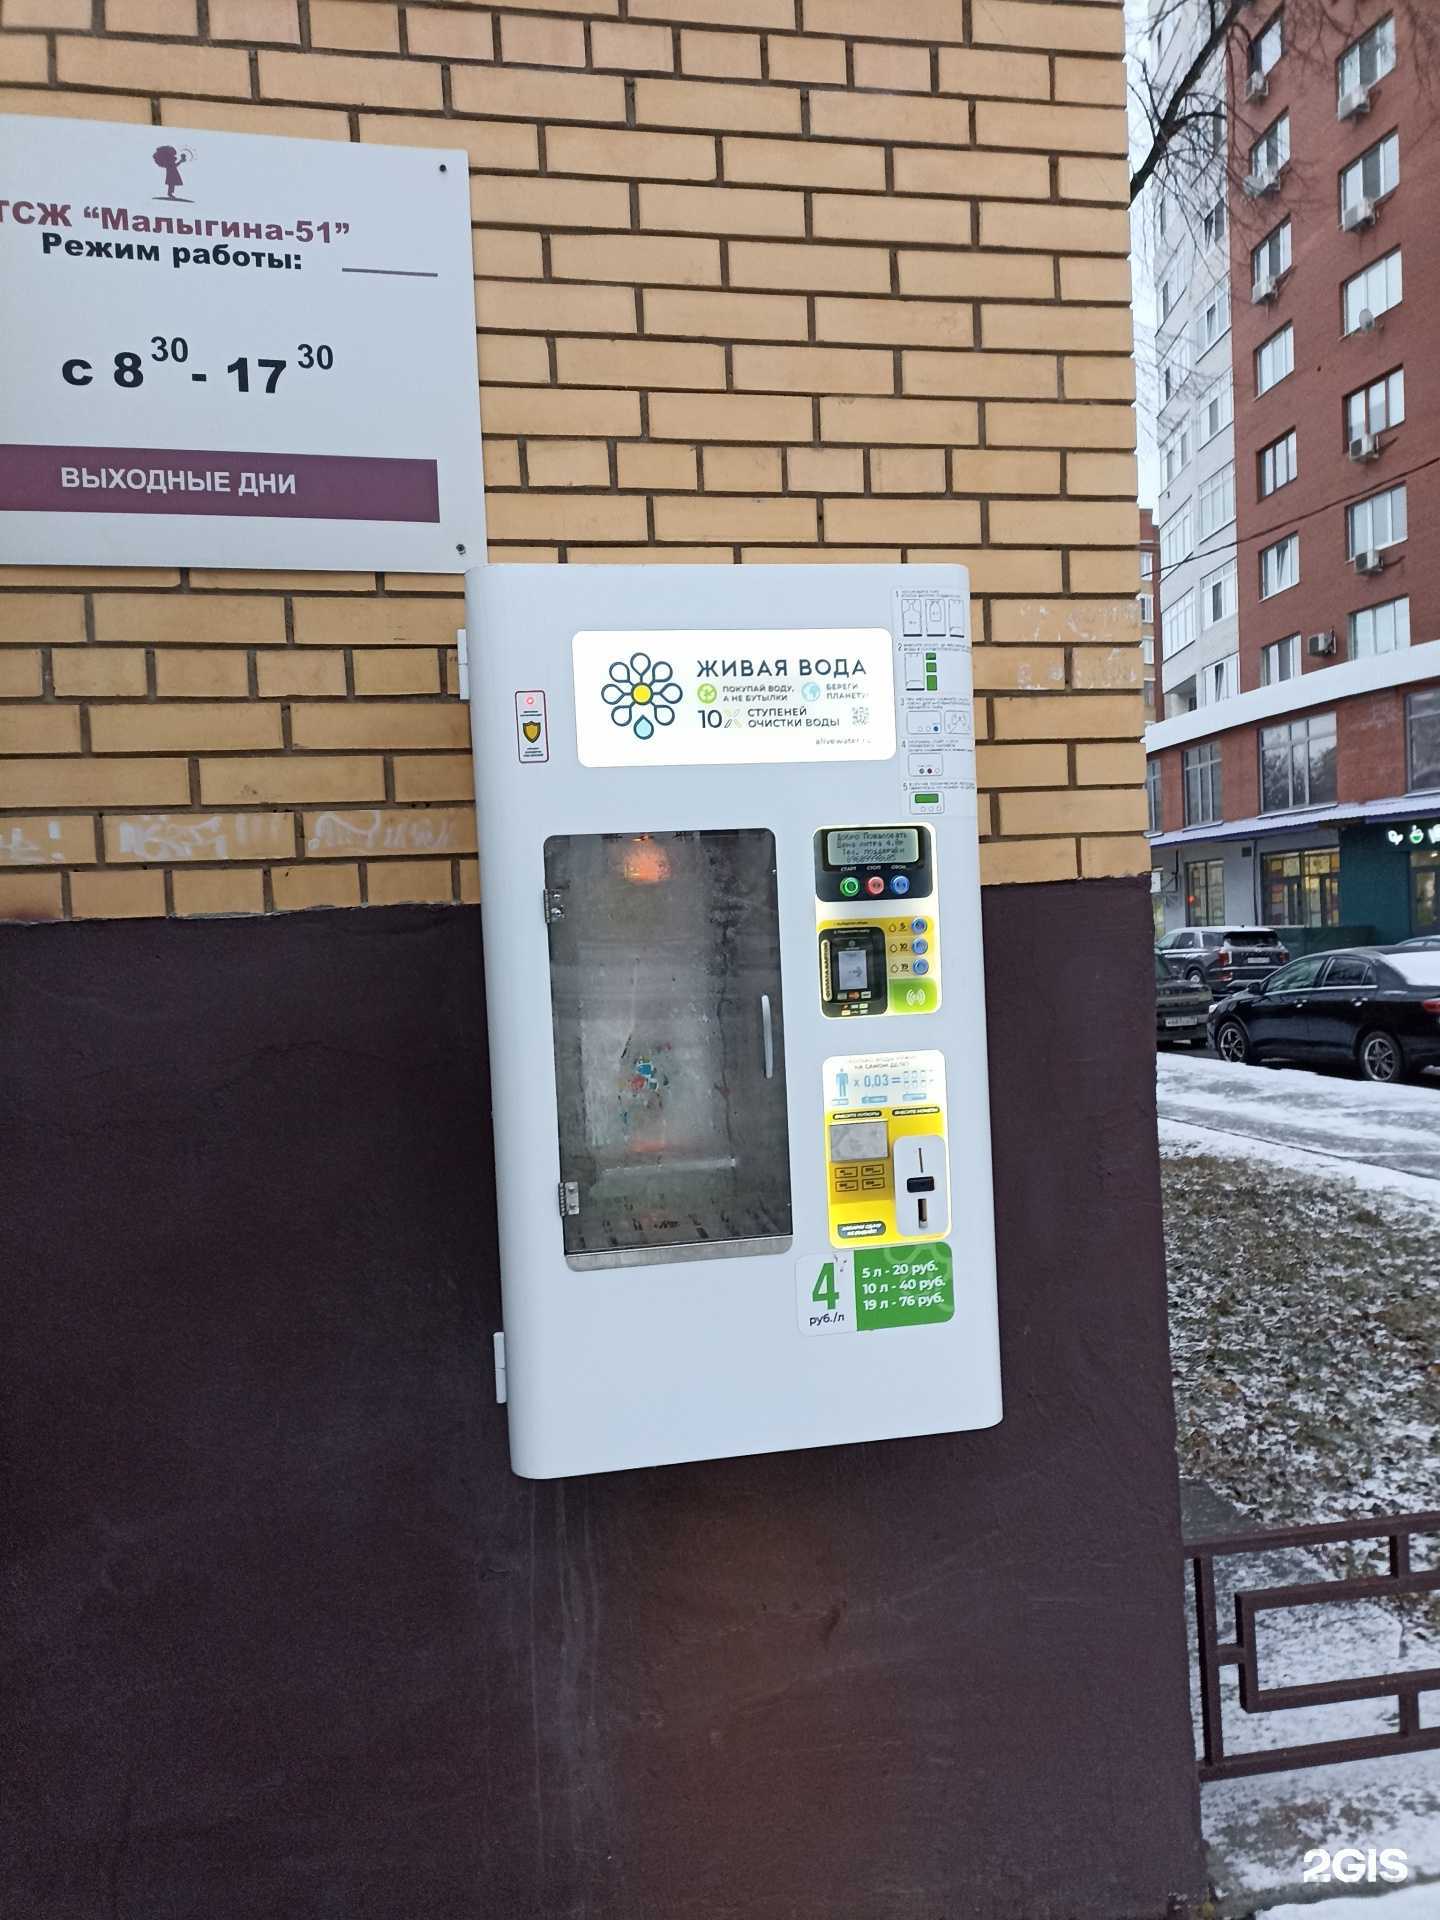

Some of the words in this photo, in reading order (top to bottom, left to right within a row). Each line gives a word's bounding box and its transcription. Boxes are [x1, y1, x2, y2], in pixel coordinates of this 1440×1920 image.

[42, 232, 160, 261] Режим
[172, 243, 302, 270] работы:
[61, 358, 94, 386] с
[61, 466, 230, 492] ВЫХОДНЫЕ
[239, 473, 296, 496] ДНИ
[697, 659, 788, 677] ЖИВАЯ
[799, 659, 867, 678] ВОДА
[722, 684, 766, 693] ПОКУПАЙ
[745, 694, 788, 702] БУТЫЛКИ
[697, 709, 723, 728] 10
[747, 706, 807, 717] СТУПЕНЕЙ
[747, 718, 802, 728] ОЧИСТКИ
[805, 718, 840, 728] ВОДЫ
[861, 1268, 871, 1278] 5
[873, 1269, 882, 1277] л
[892, 1263, 909, 1276] 20
[911, 1260, 938, 1276] руб.
[812, 1262, 840, 1310] 4
[862, 1283, 877, 1294] 10
[879, 1283, 888, 1292] л
[899, 1279, 916, 1291] 40
[919, 1275, 945, 1291] руб.
[863, 1300, 877, 1311] 19
[879, 1299, 889, 1309] л
[898, 1295, 915, 1307] 76
[918, 1291, 944, 1308] руб.
[809, 1313, 845, 1327] руб./л
